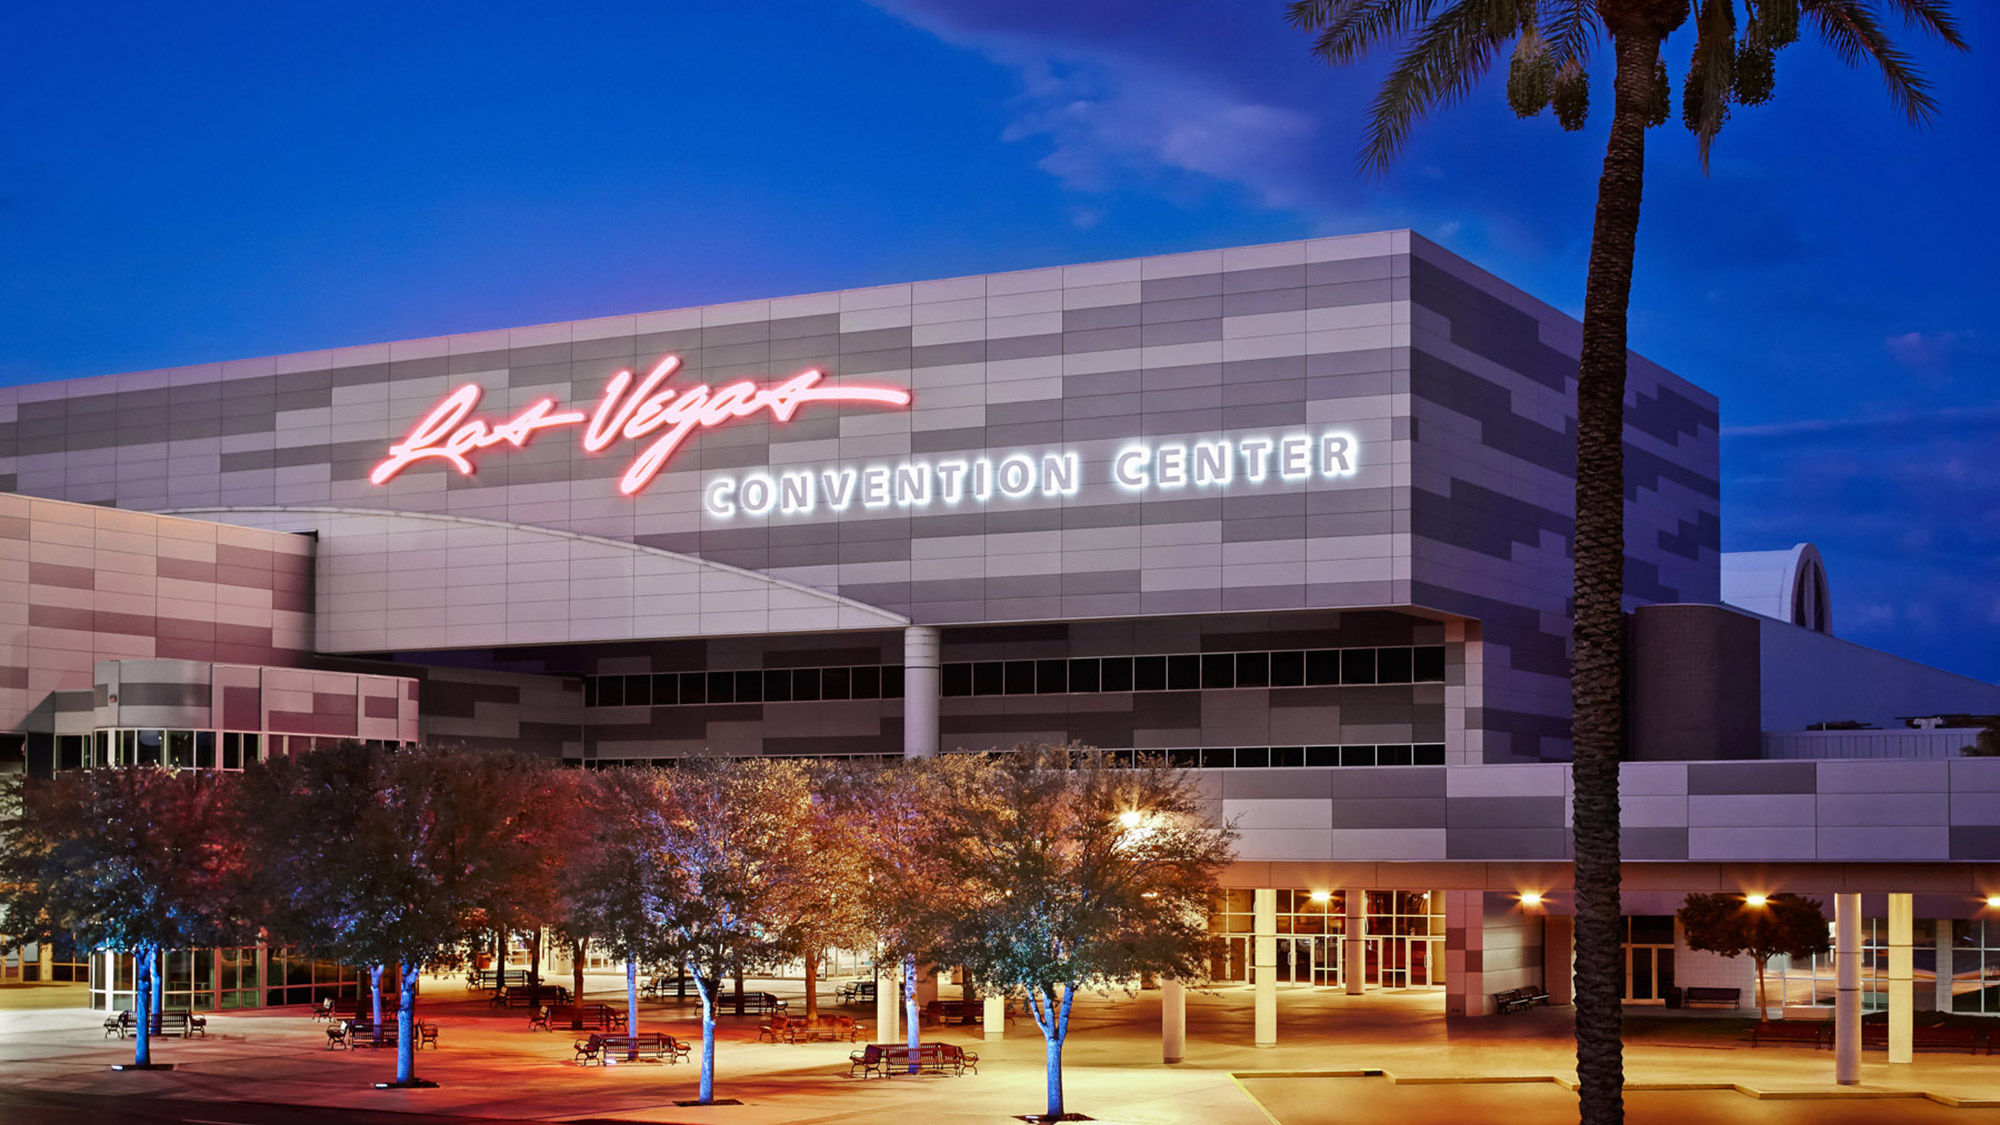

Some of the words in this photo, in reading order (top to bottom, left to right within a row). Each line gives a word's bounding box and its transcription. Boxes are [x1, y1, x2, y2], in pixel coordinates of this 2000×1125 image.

[370, 383, 585, 485] Las
[584, 355, 911, 495] Vegas
[706, 456, 1076, 516] CONVENTION
[1115, 435, 1354, 487] CENTER
